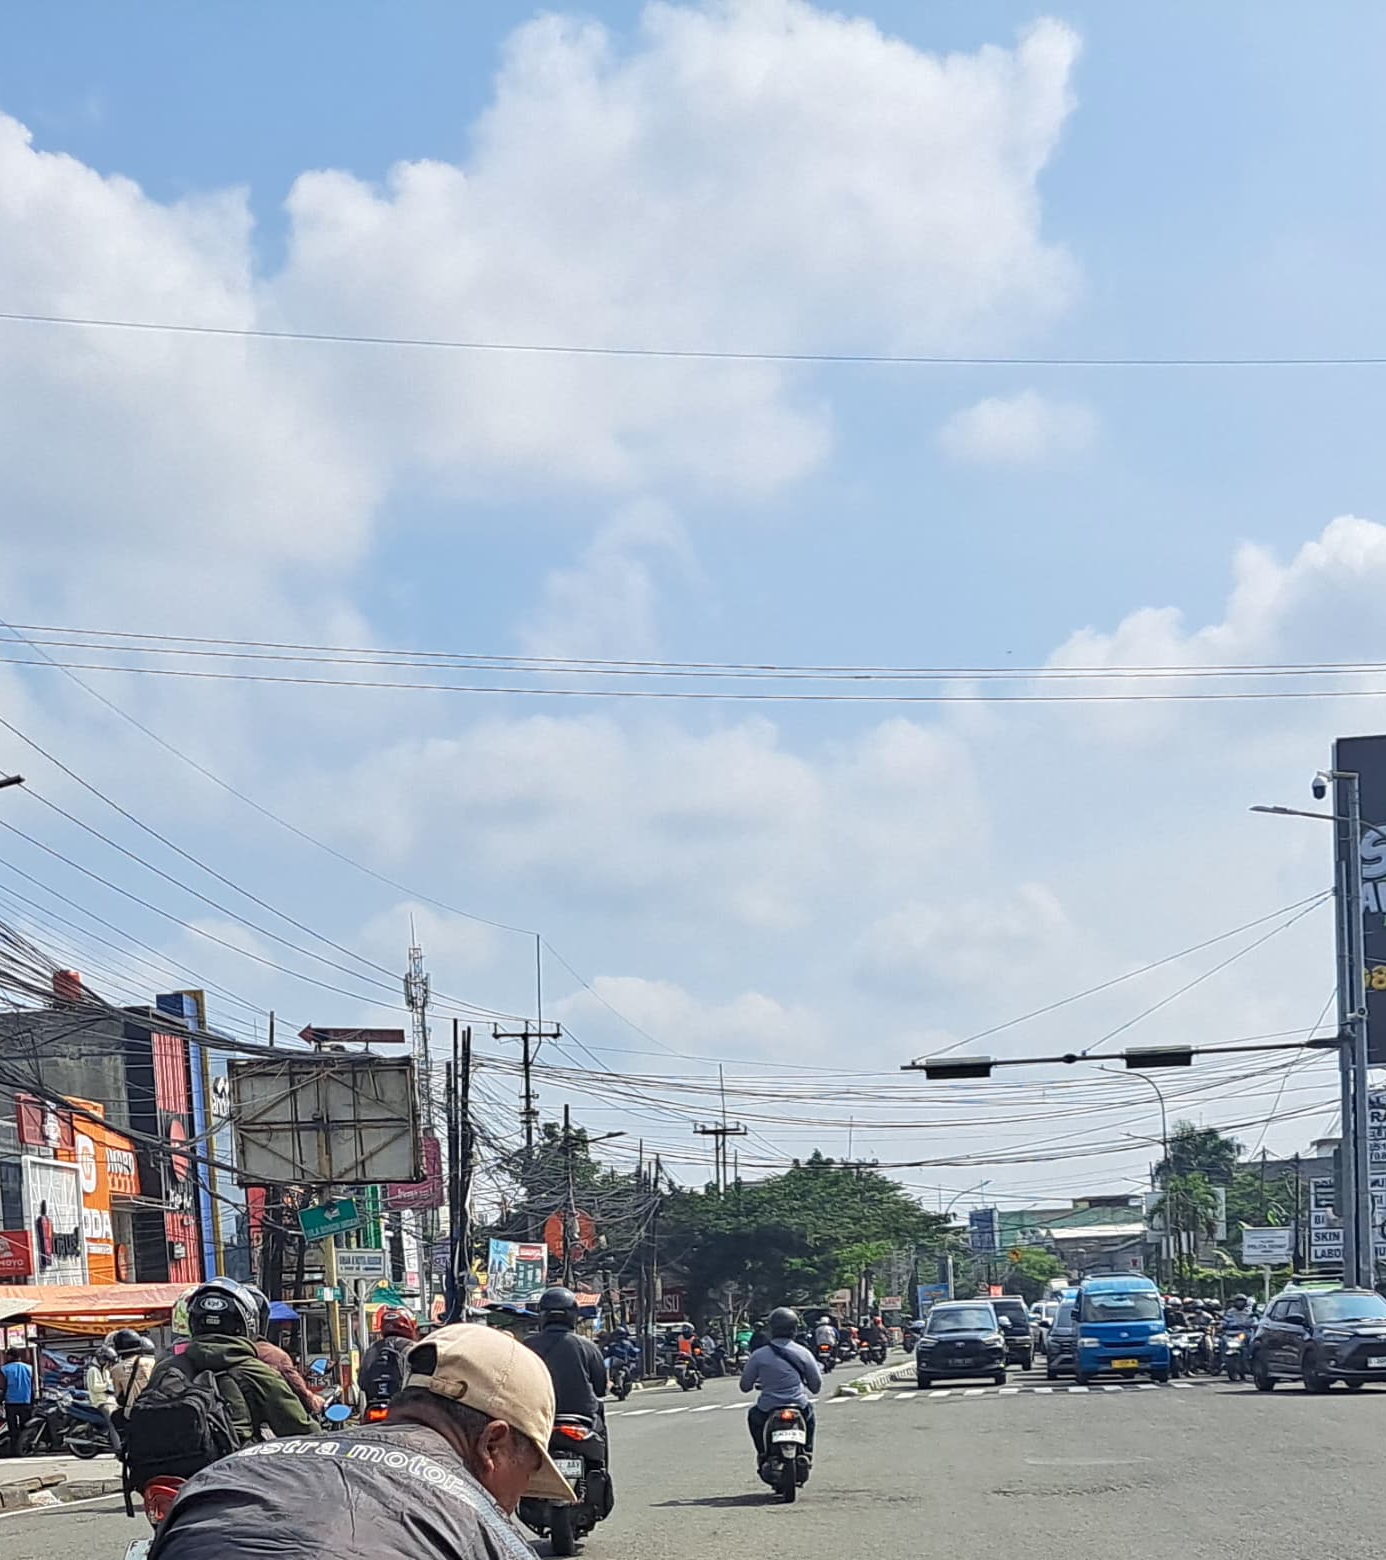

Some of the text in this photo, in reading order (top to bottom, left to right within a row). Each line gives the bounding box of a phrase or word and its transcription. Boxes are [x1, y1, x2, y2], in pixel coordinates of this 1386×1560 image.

[1314, 1231, 1341, 1242] SKIN
[237, 1438, 464, 1493] astra motor
